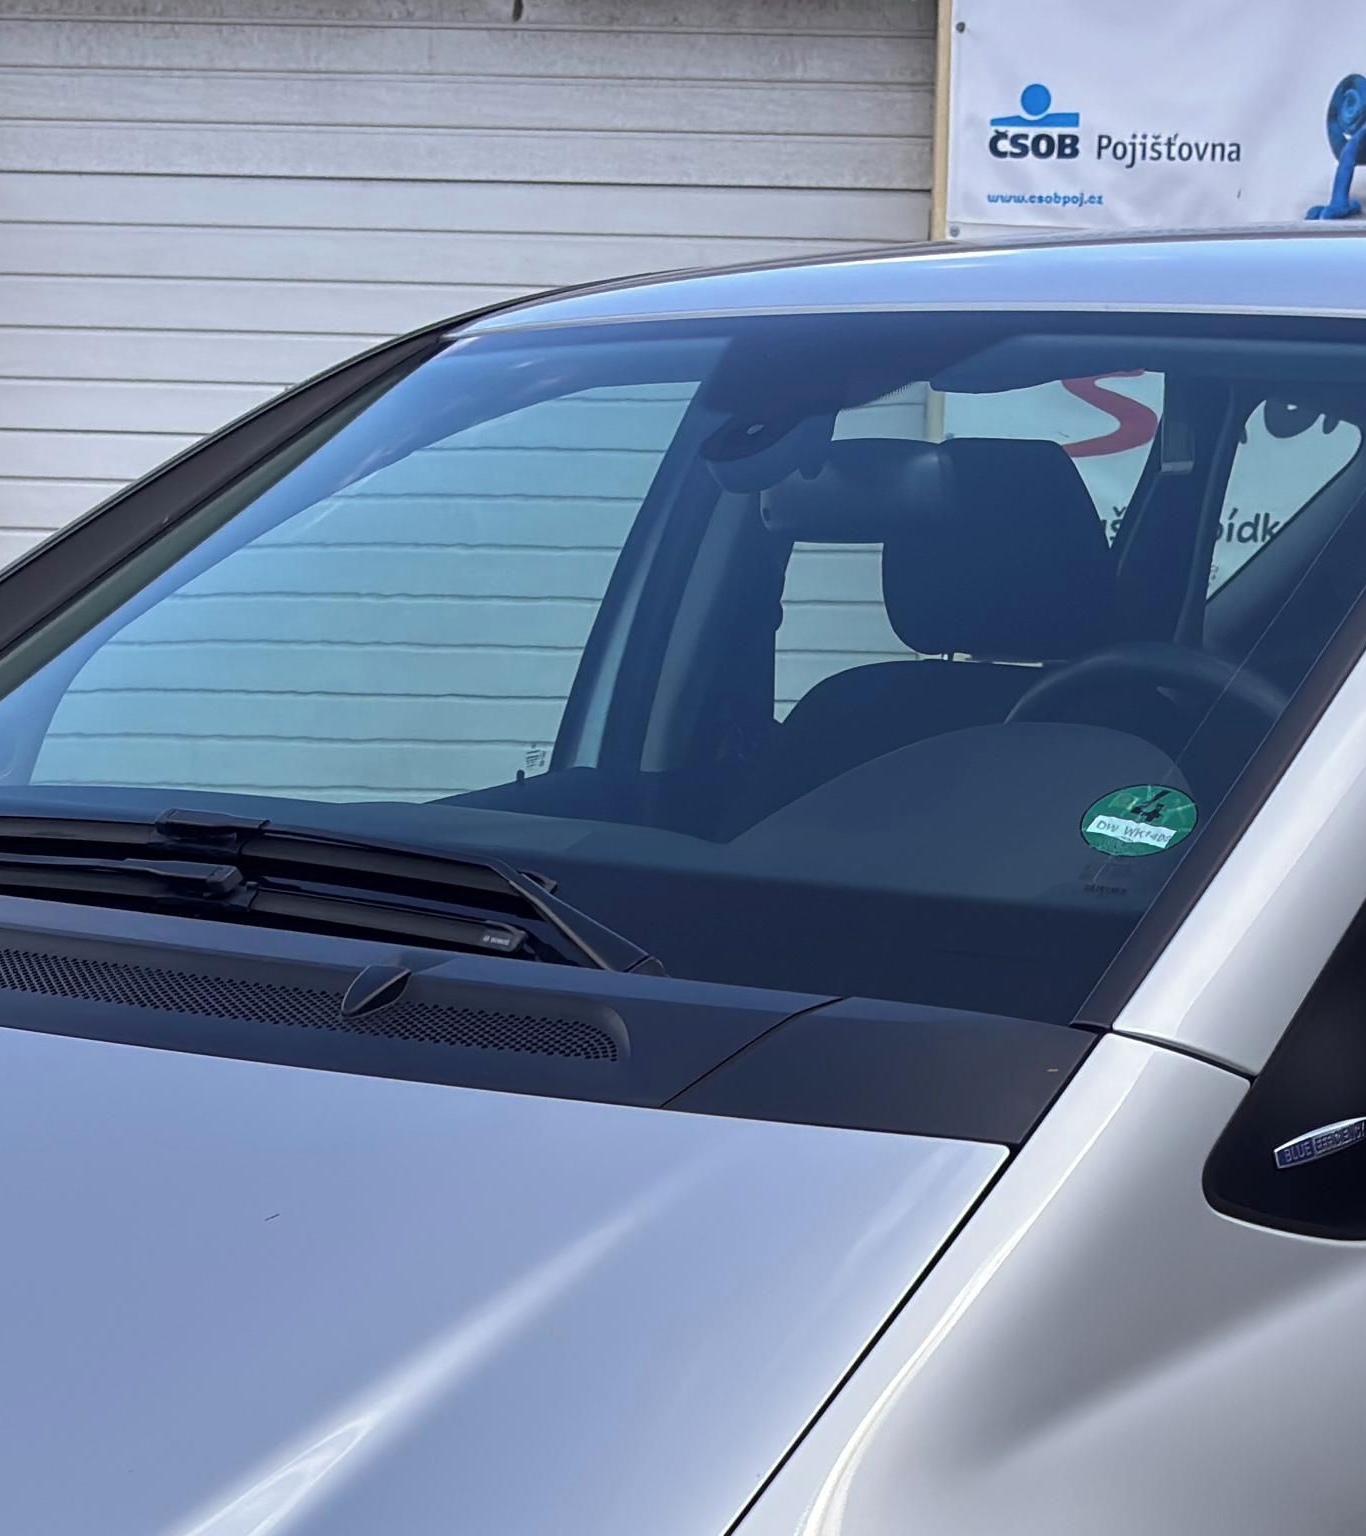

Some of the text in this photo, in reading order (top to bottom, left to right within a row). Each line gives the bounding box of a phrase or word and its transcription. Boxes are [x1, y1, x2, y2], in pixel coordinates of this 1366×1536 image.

[989, 130, 1242, 168] ČSOB Pojišťovna
[987, 192, 1103, 207] www.csobpoj.cz
[1284, 1140, 1312, 1162] BLUE
